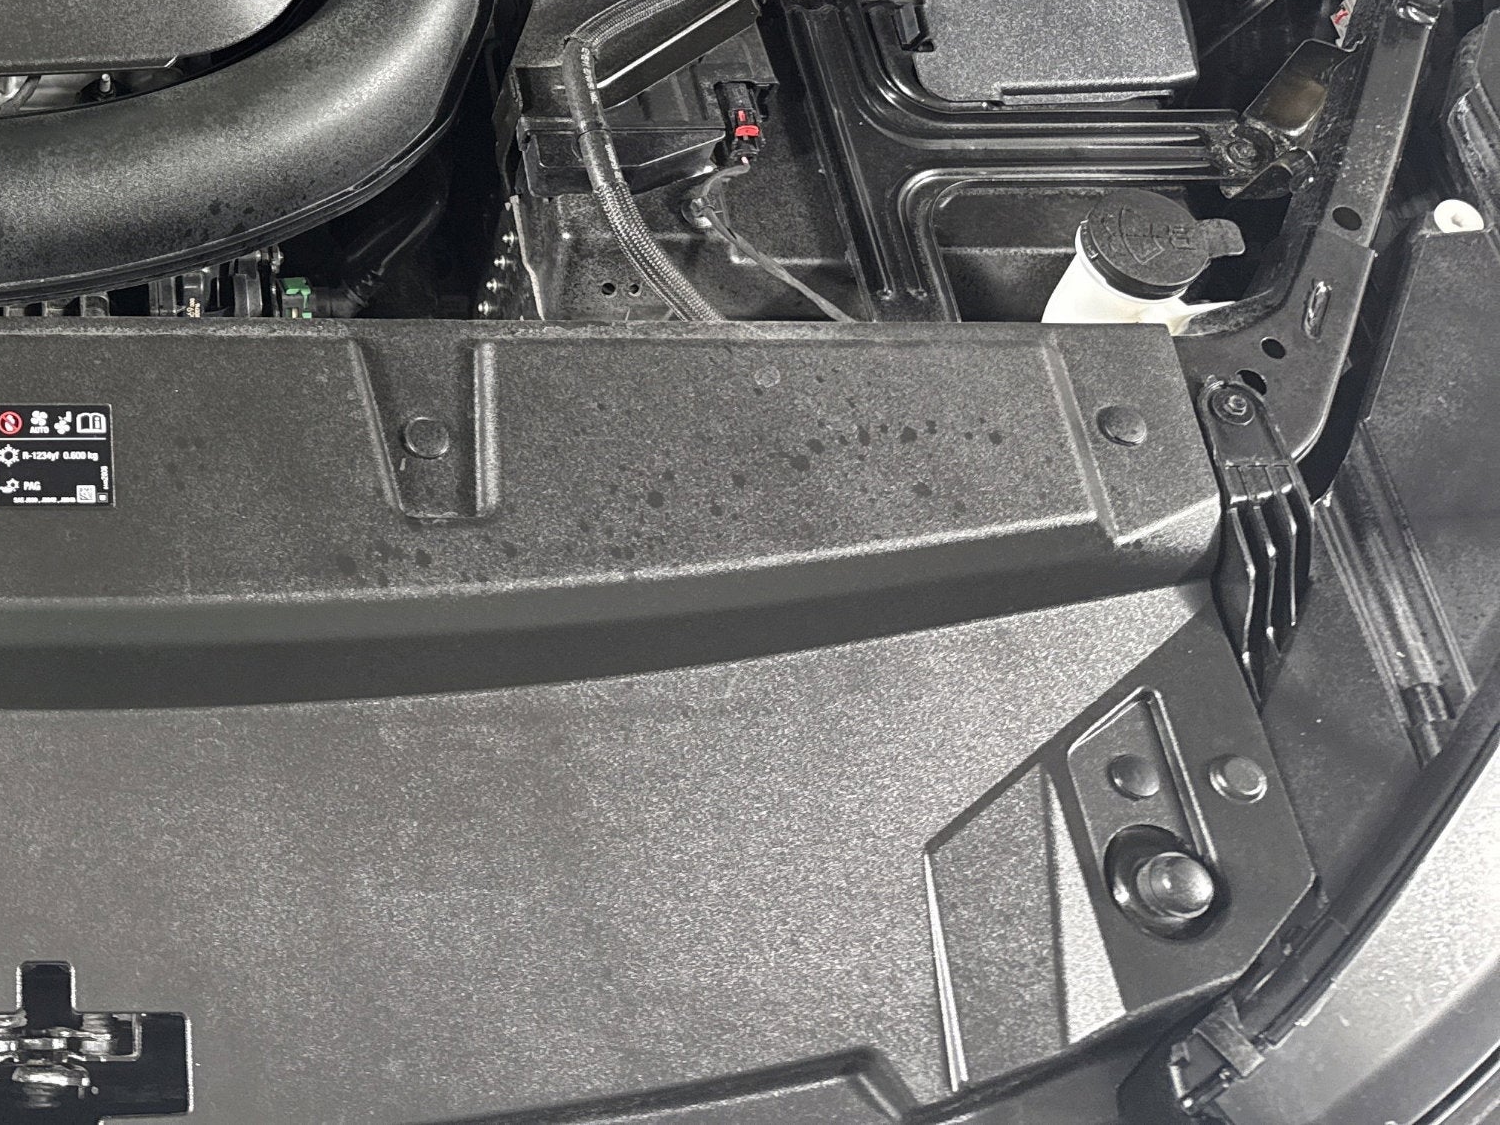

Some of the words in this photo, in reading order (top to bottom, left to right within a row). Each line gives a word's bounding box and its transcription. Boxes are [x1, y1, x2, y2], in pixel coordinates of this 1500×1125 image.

[30, 426, 50, 434] AUTO
[22, 451, 60, 461] R-1234yf
[87, 451, 99, 461] kg
[23, 481, 42, 491] PAG
